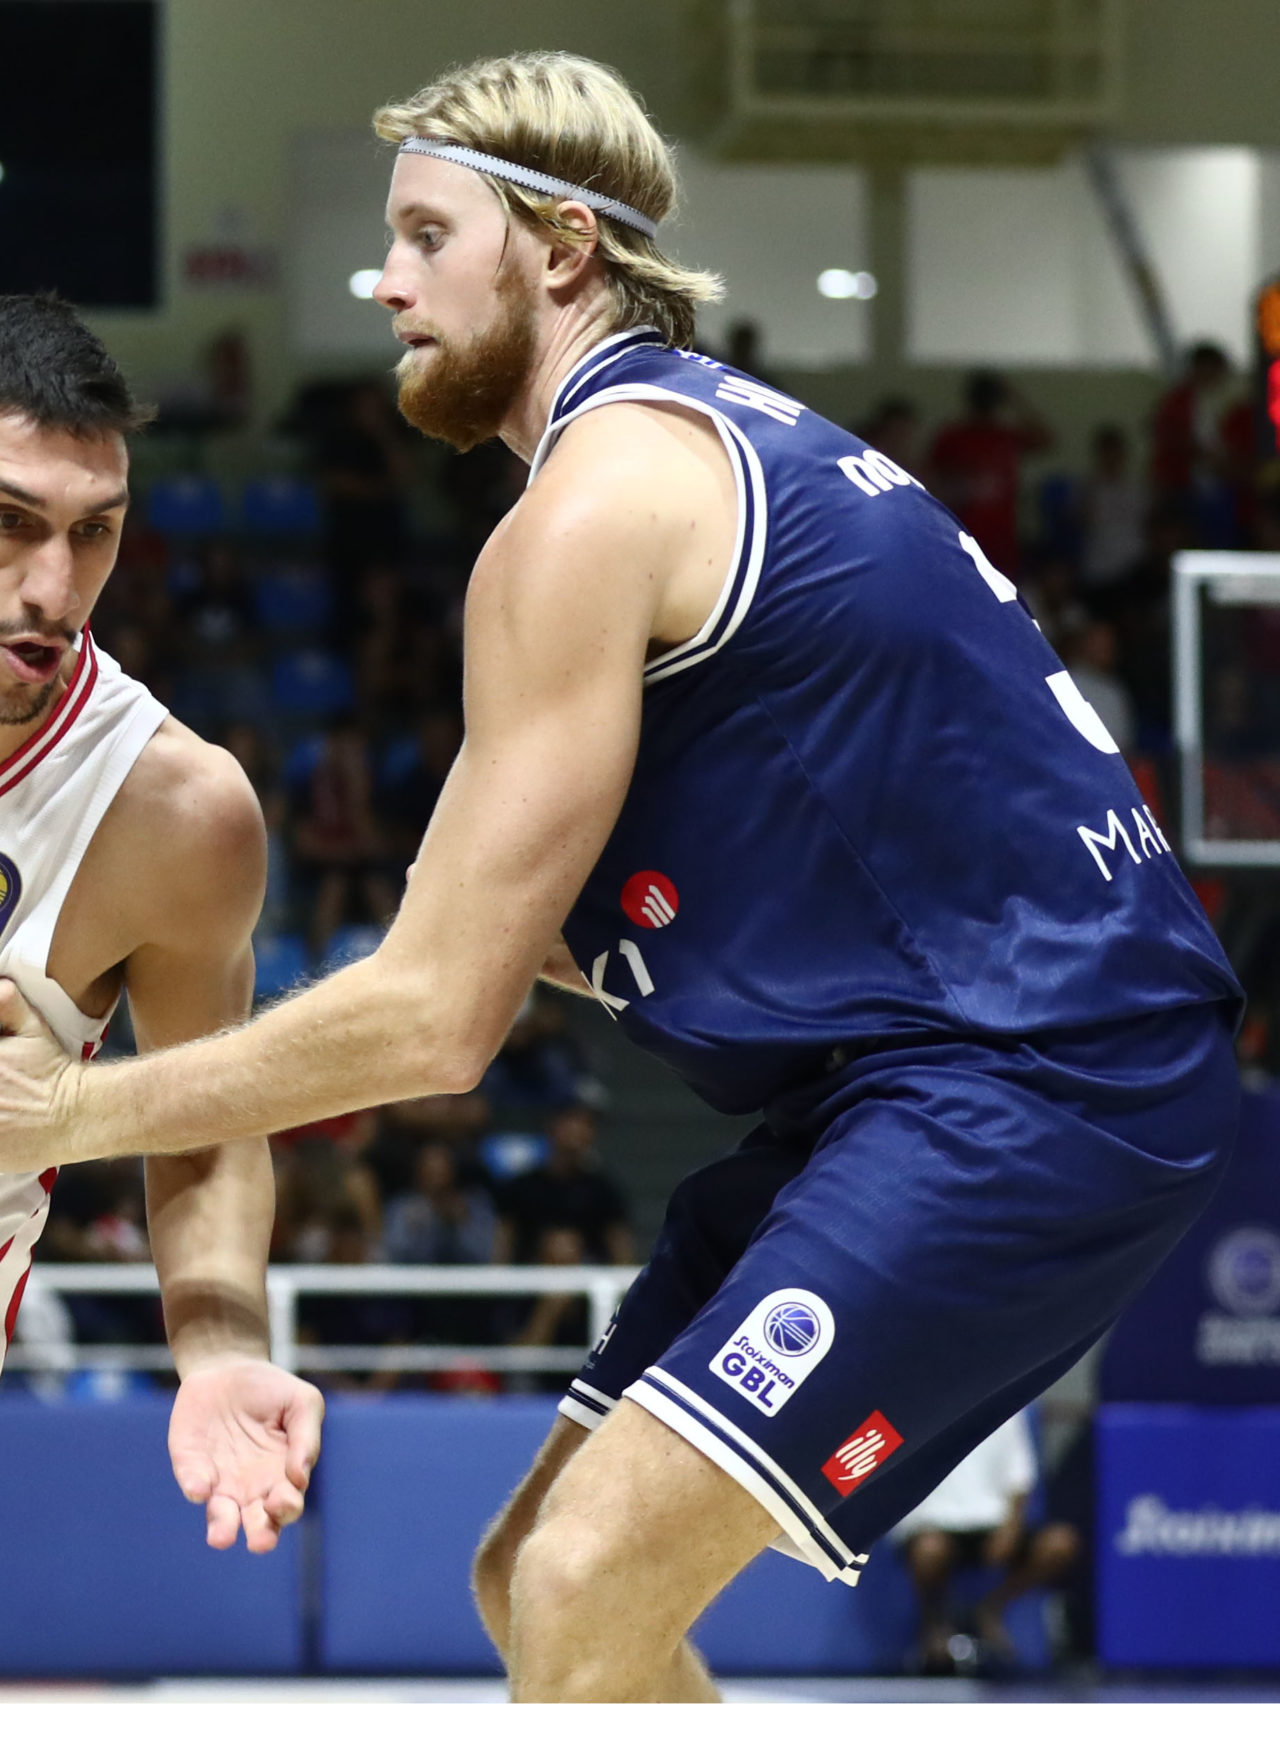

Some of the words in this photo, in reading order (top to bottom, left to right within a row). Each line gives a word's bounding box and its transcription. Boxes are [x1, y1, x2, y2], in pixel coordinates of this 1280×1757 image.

[722, 1352, 774, 1408] GBL
[733, 1335, 796, 1389] Stoiximan
[835, 1429, 886, 1480] illy
